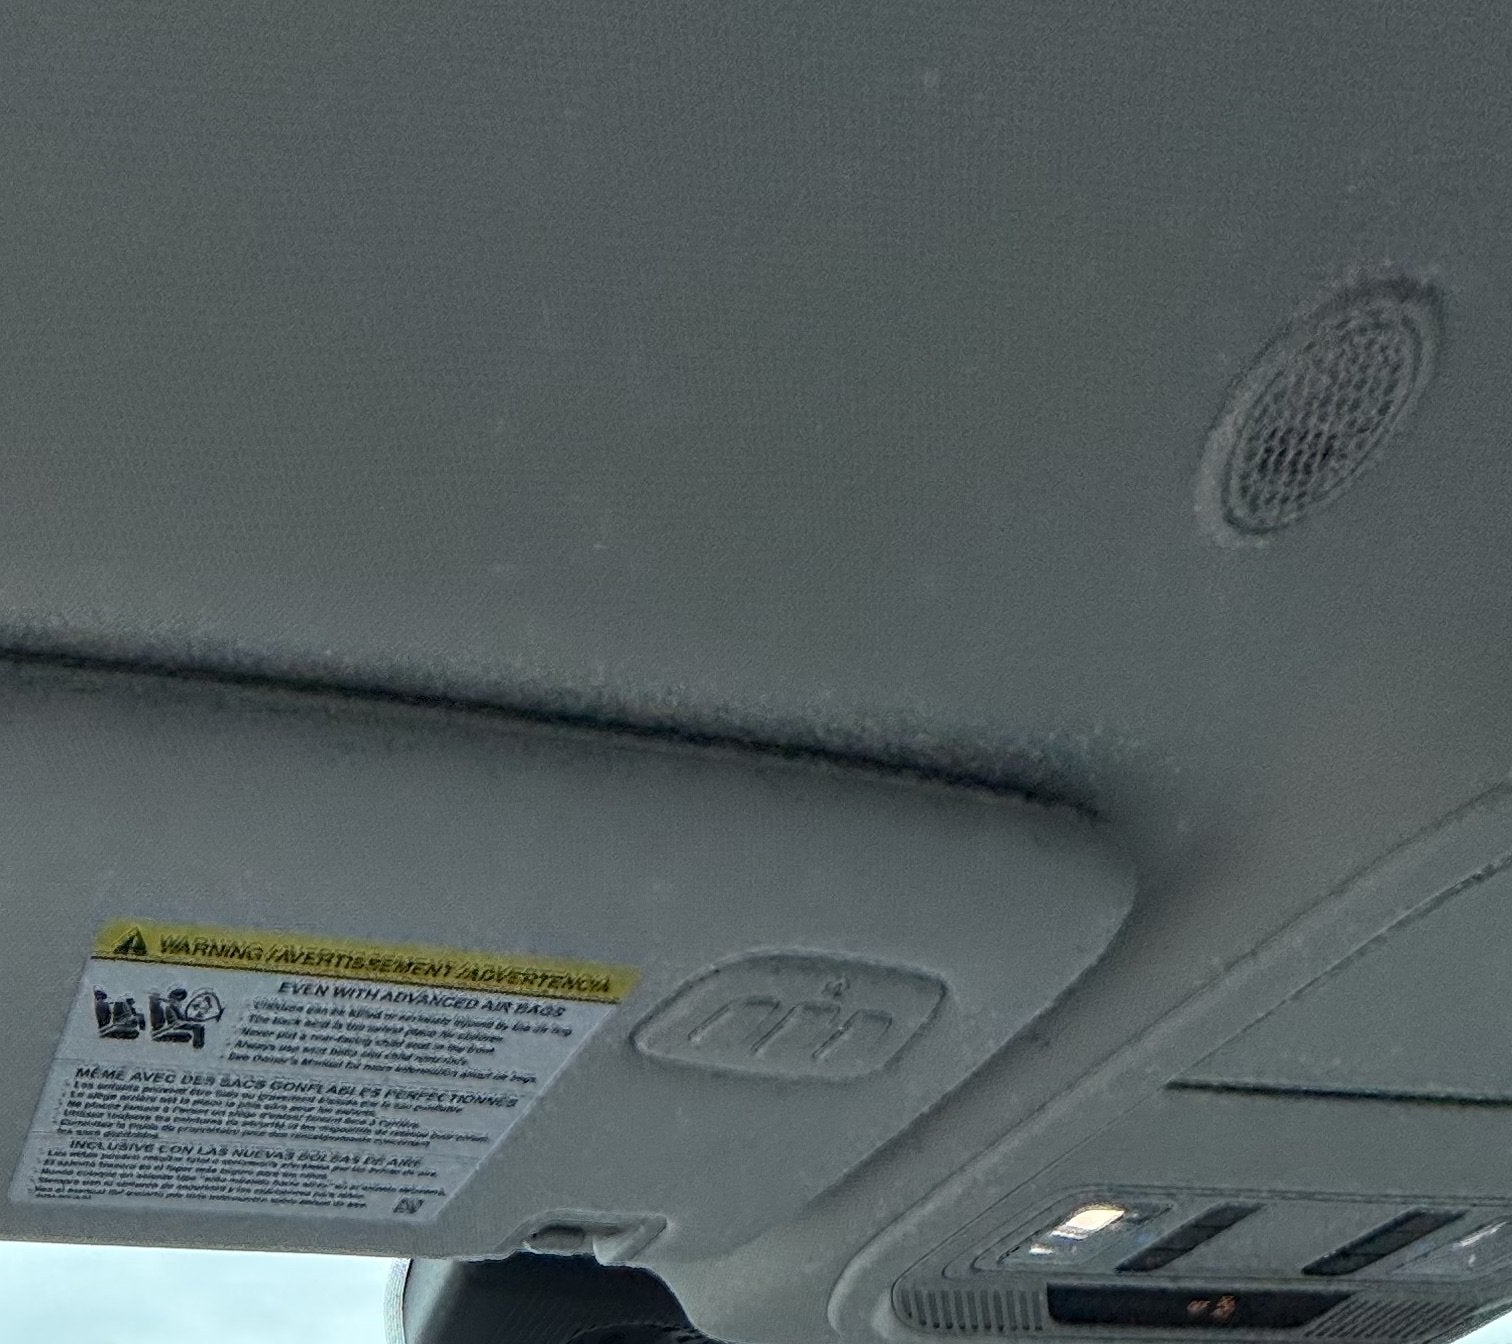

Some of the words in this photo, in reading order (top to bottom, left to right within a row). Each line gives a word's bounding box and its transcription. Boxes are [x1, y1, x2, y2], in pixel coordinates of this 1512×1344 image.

[278, 981, 330, 998] EVEN
[332, 984, 381, 1001] WITH
[380, 989, 478, 1011] ADVANCED
[481, 999, 513, 1014] AIR
[514, 1002, 566, 1018] BAGS
[130, 1070, 177, 1084] AVEC
[158, 1144, 194, 1155] CON
